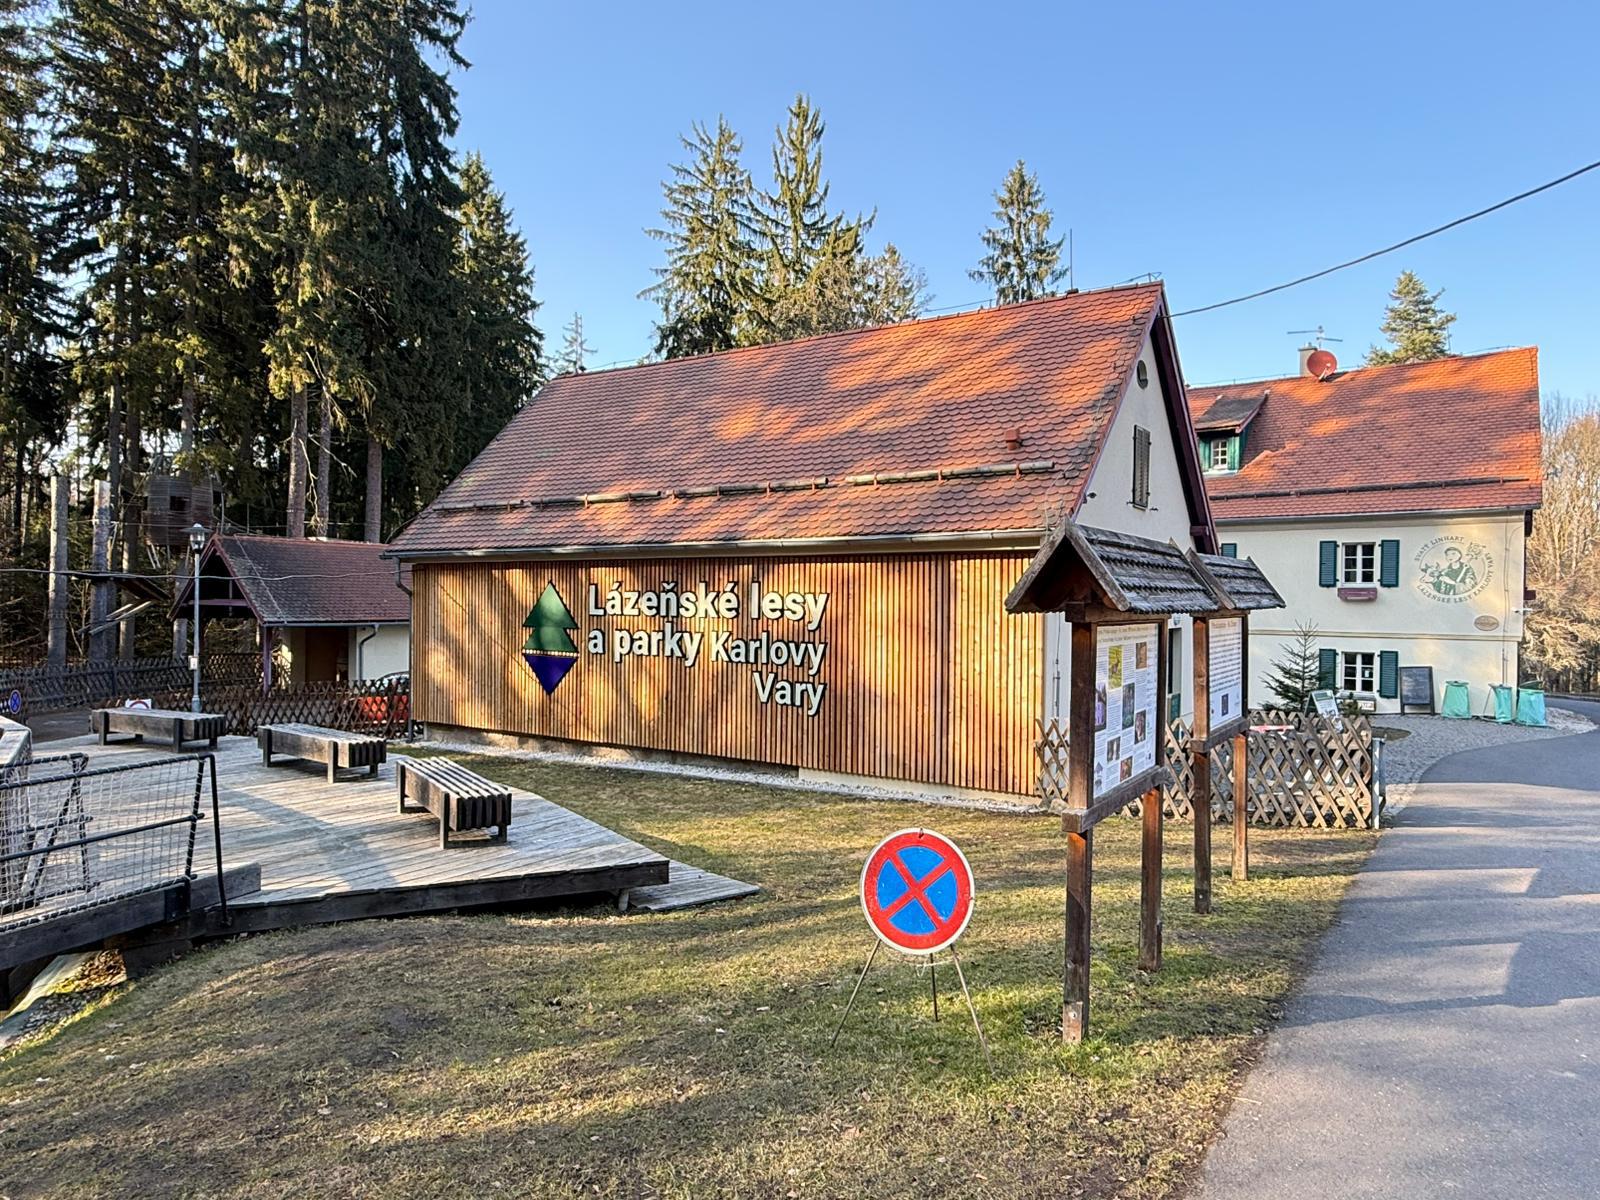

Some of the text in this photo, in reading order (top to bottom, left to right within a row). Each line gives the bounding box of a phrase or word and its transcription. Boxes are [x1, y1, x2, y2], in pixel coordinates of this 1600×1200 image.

[588, 581, 828, 630] Lázeňské lesy
[588, 621, 828, 676] a parky Karlovy
[753, 671, 827, 716] Vary
